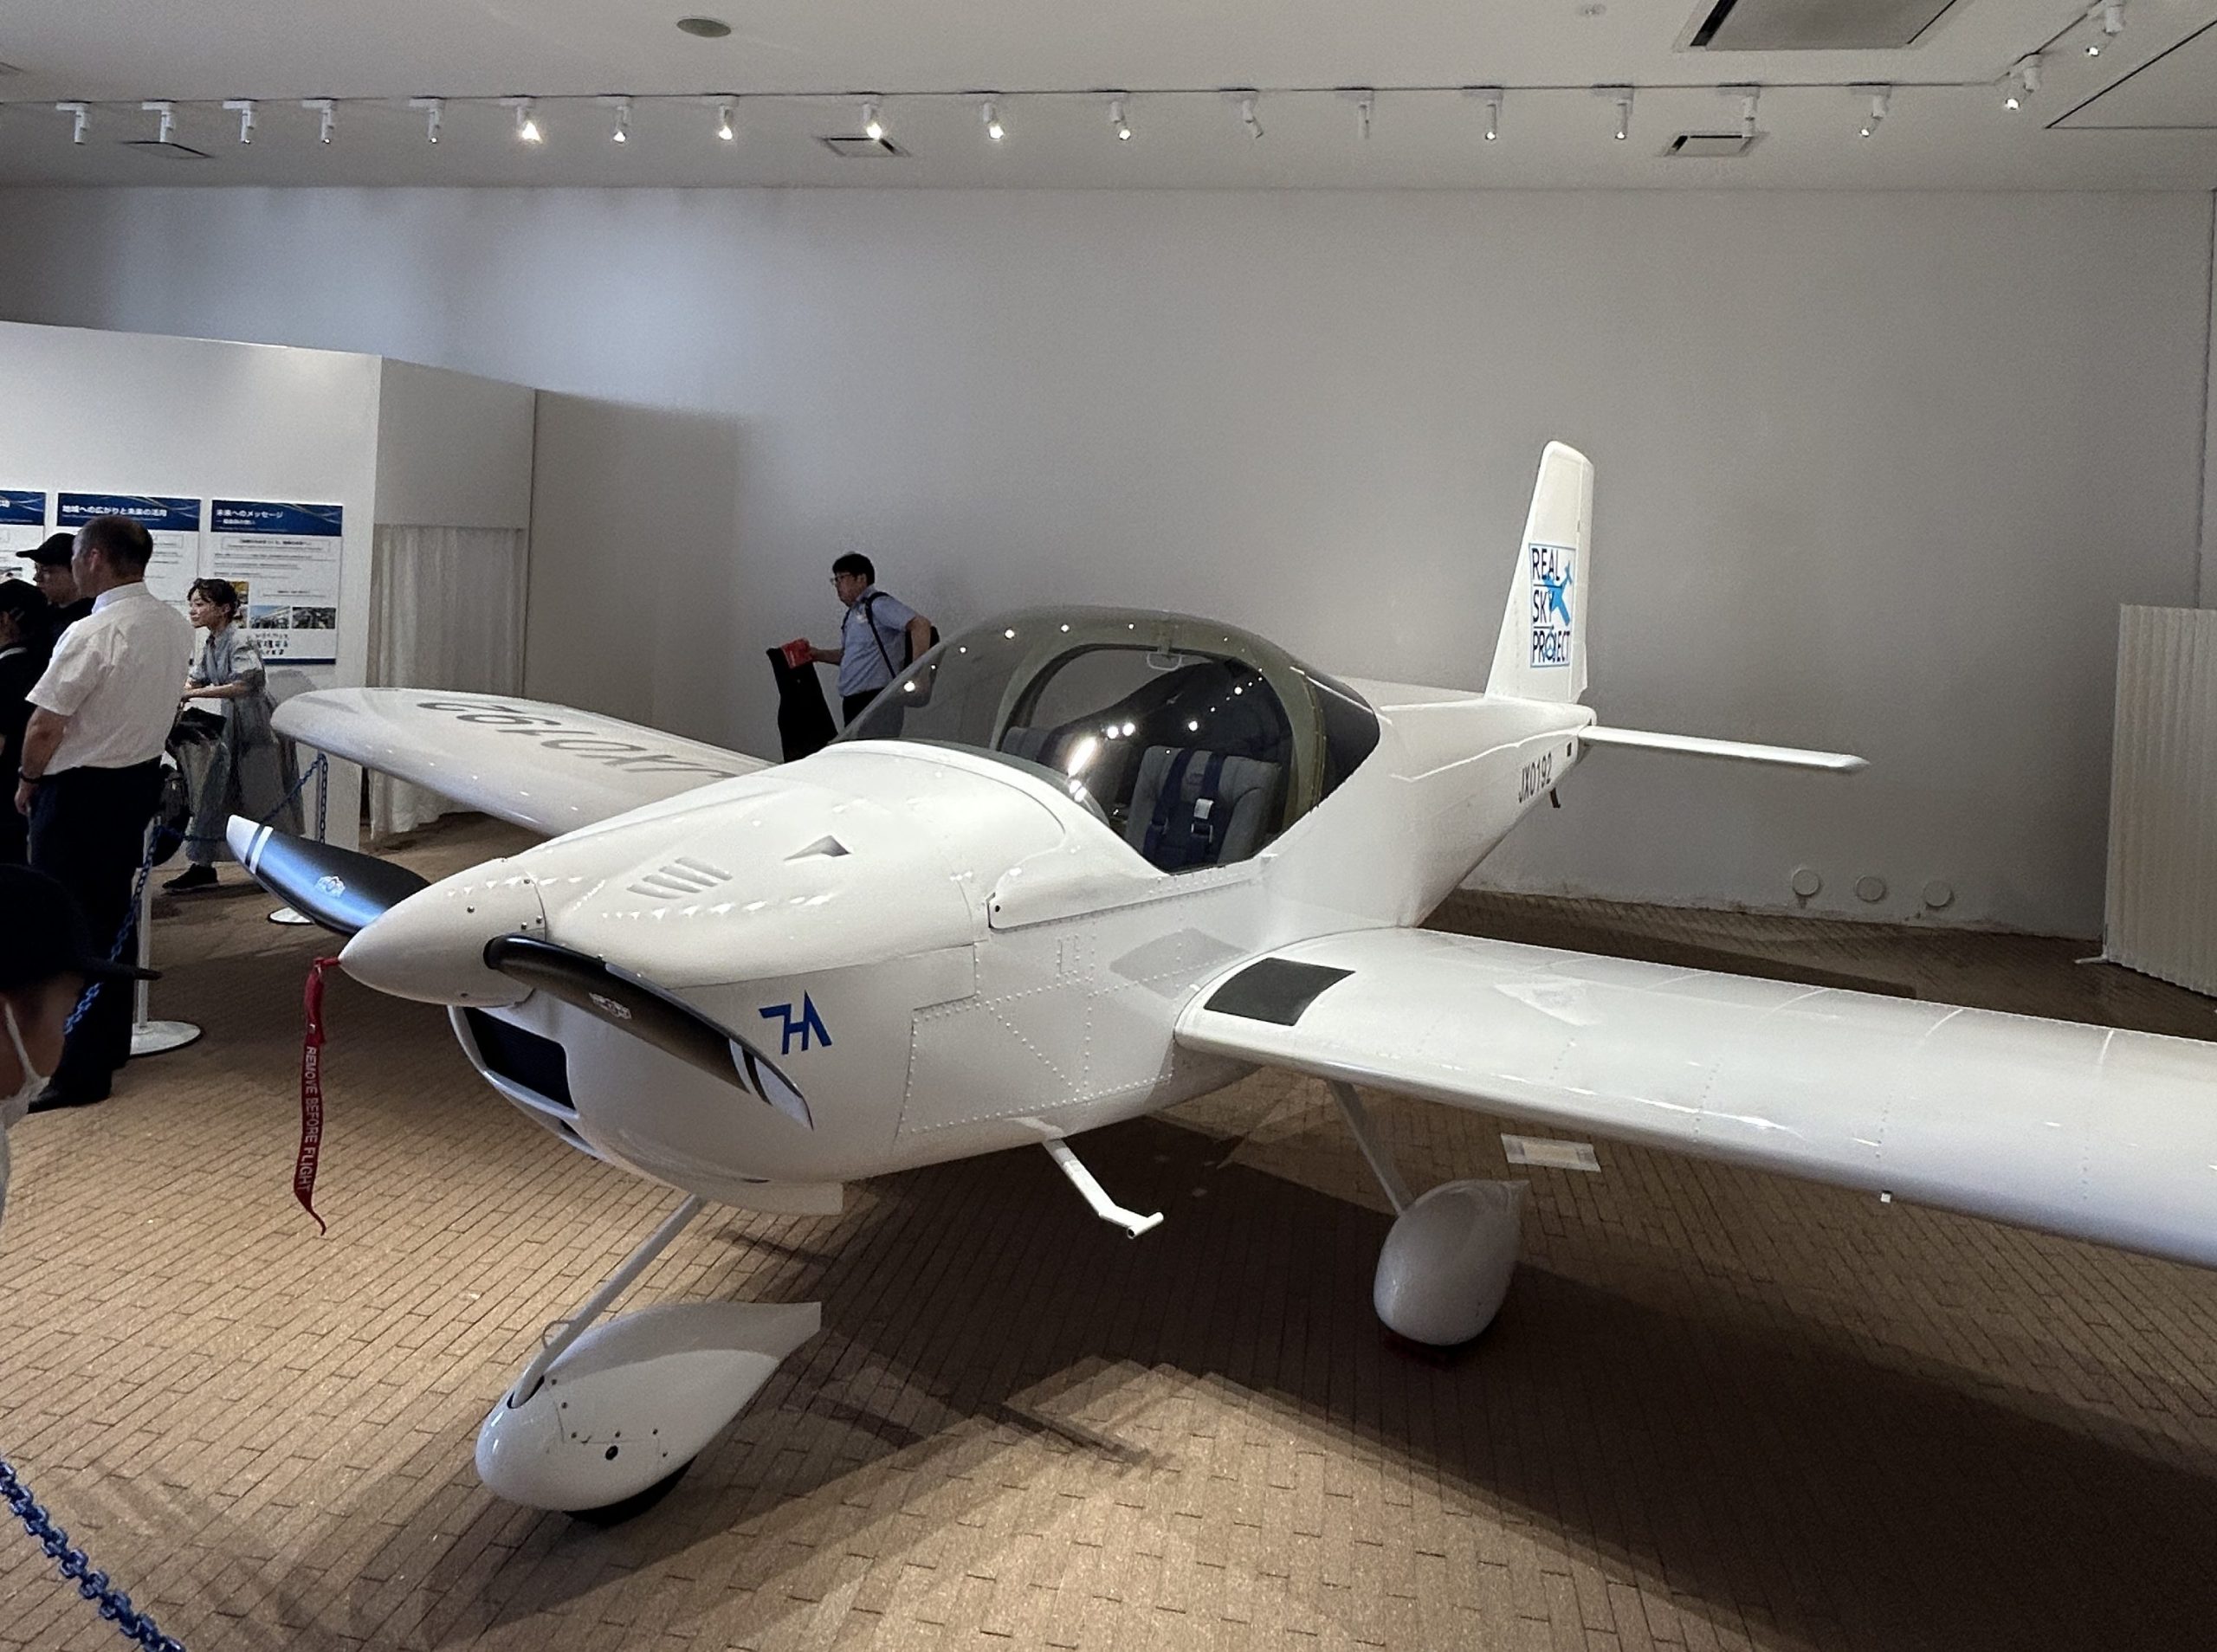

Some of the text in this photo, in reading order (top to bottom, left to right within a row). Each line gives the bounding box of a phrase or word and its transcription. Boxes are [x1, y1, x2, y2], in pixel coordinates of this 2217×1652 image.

[1531, 548, 1560, 581] REAL
[1533, 590, 1555, 623] SKY
[1532, 630, 1570, 663] PROJECT
[1518, 751, 1552, 803] JX0192
[298, 1046, 320, 1192] REMOVE BEFORE FLIGHT
